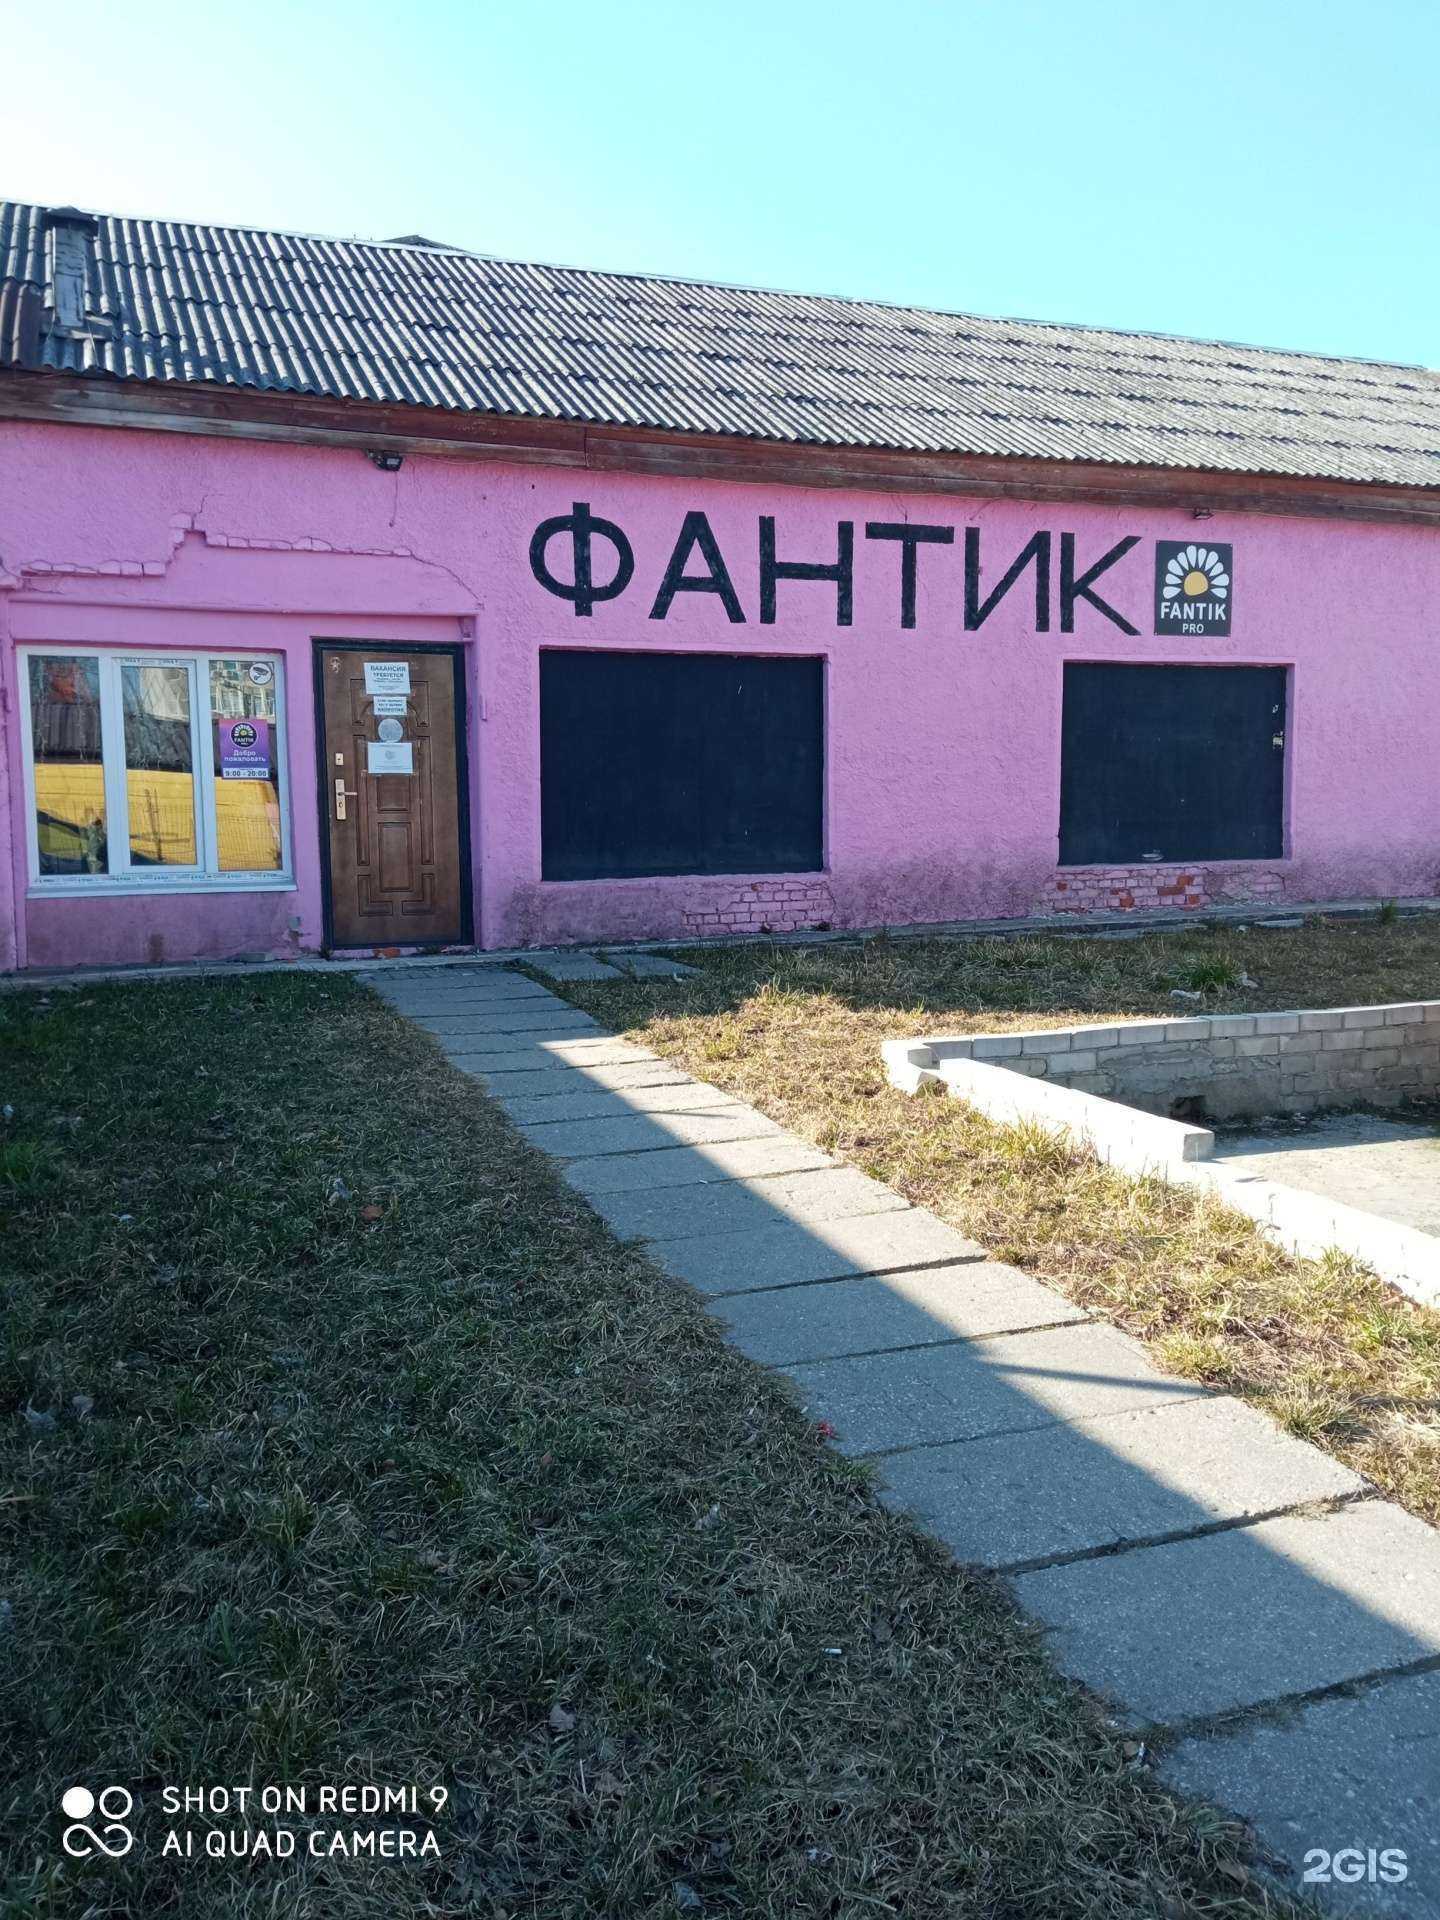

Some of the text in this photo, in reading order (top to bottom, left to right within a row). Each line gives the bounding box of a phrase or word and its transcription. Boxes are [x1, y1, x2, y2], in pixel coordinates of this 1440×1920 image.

[529, 502, 1142, 636] ФАНТИК
[1160, 601, 1227, 621] FANTIK
[1182, 623, 1204, 634] PRO
